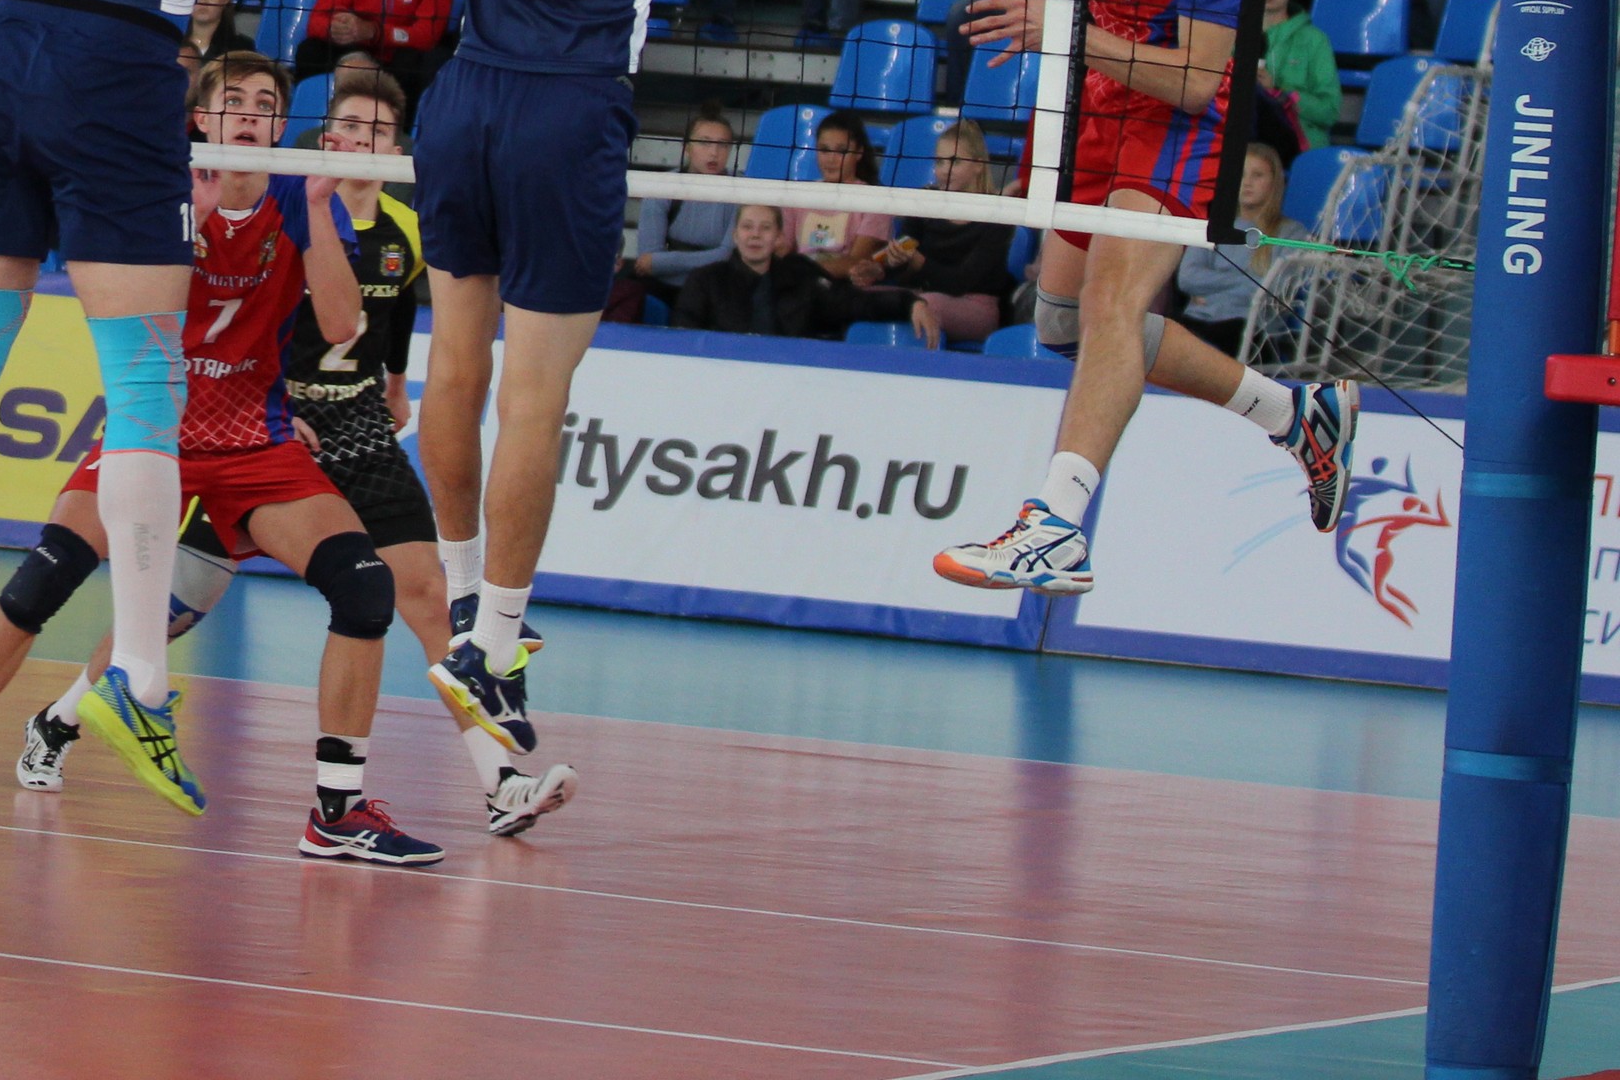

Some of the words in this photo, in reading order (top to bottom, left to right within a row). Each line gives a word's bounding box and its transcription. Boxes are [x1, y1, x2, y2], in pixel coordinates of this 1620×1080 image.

[1502, 94, 1554, 274] JINLING
[202, 298, 244, 344] 7
[318, 309, 369, 372] 2
[557, 412, 970, 520] itysakh.ru
